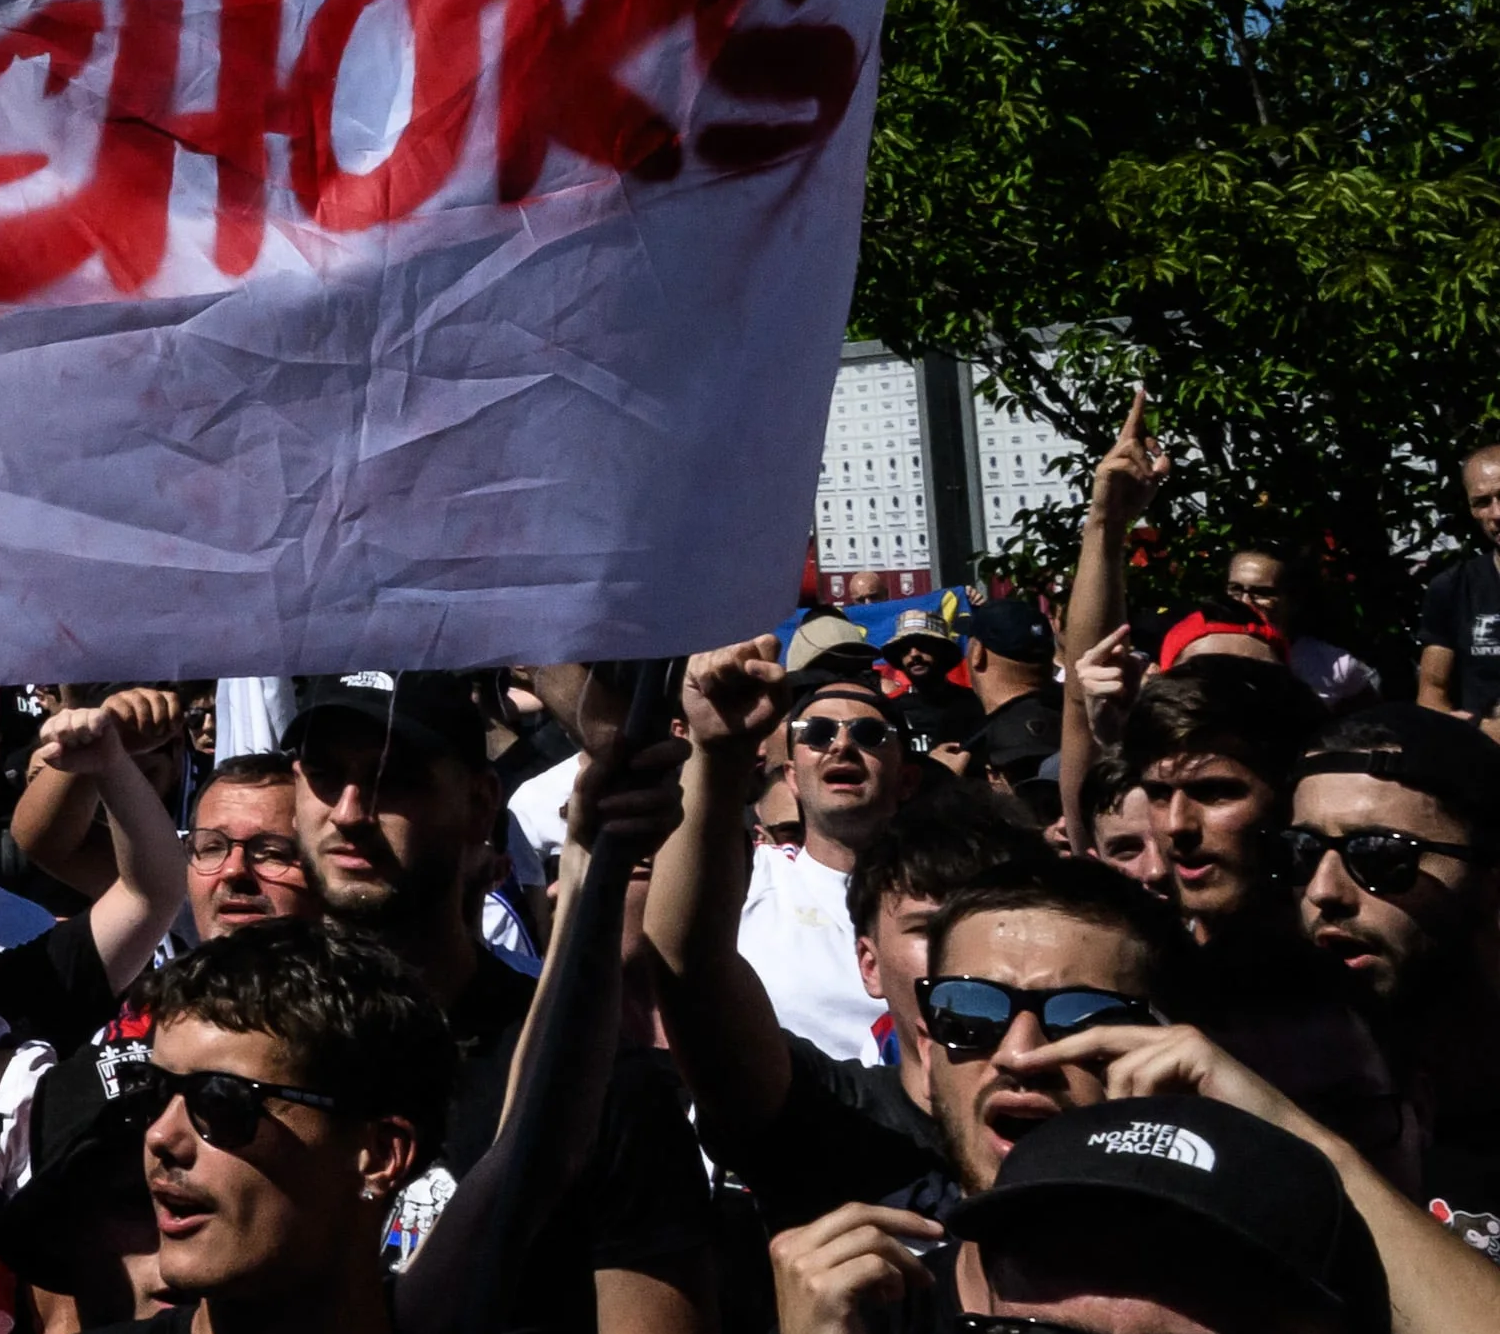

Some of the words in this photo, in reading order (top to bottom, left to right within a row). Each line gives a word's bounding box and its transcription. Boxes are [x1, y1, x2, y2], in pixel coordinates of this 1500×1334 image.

[1129, 1121, 1178, 1134] THE
[1087, 1130, 1174, 1147] NORTH
[1104, 1140, 1167, 1158] FACE
